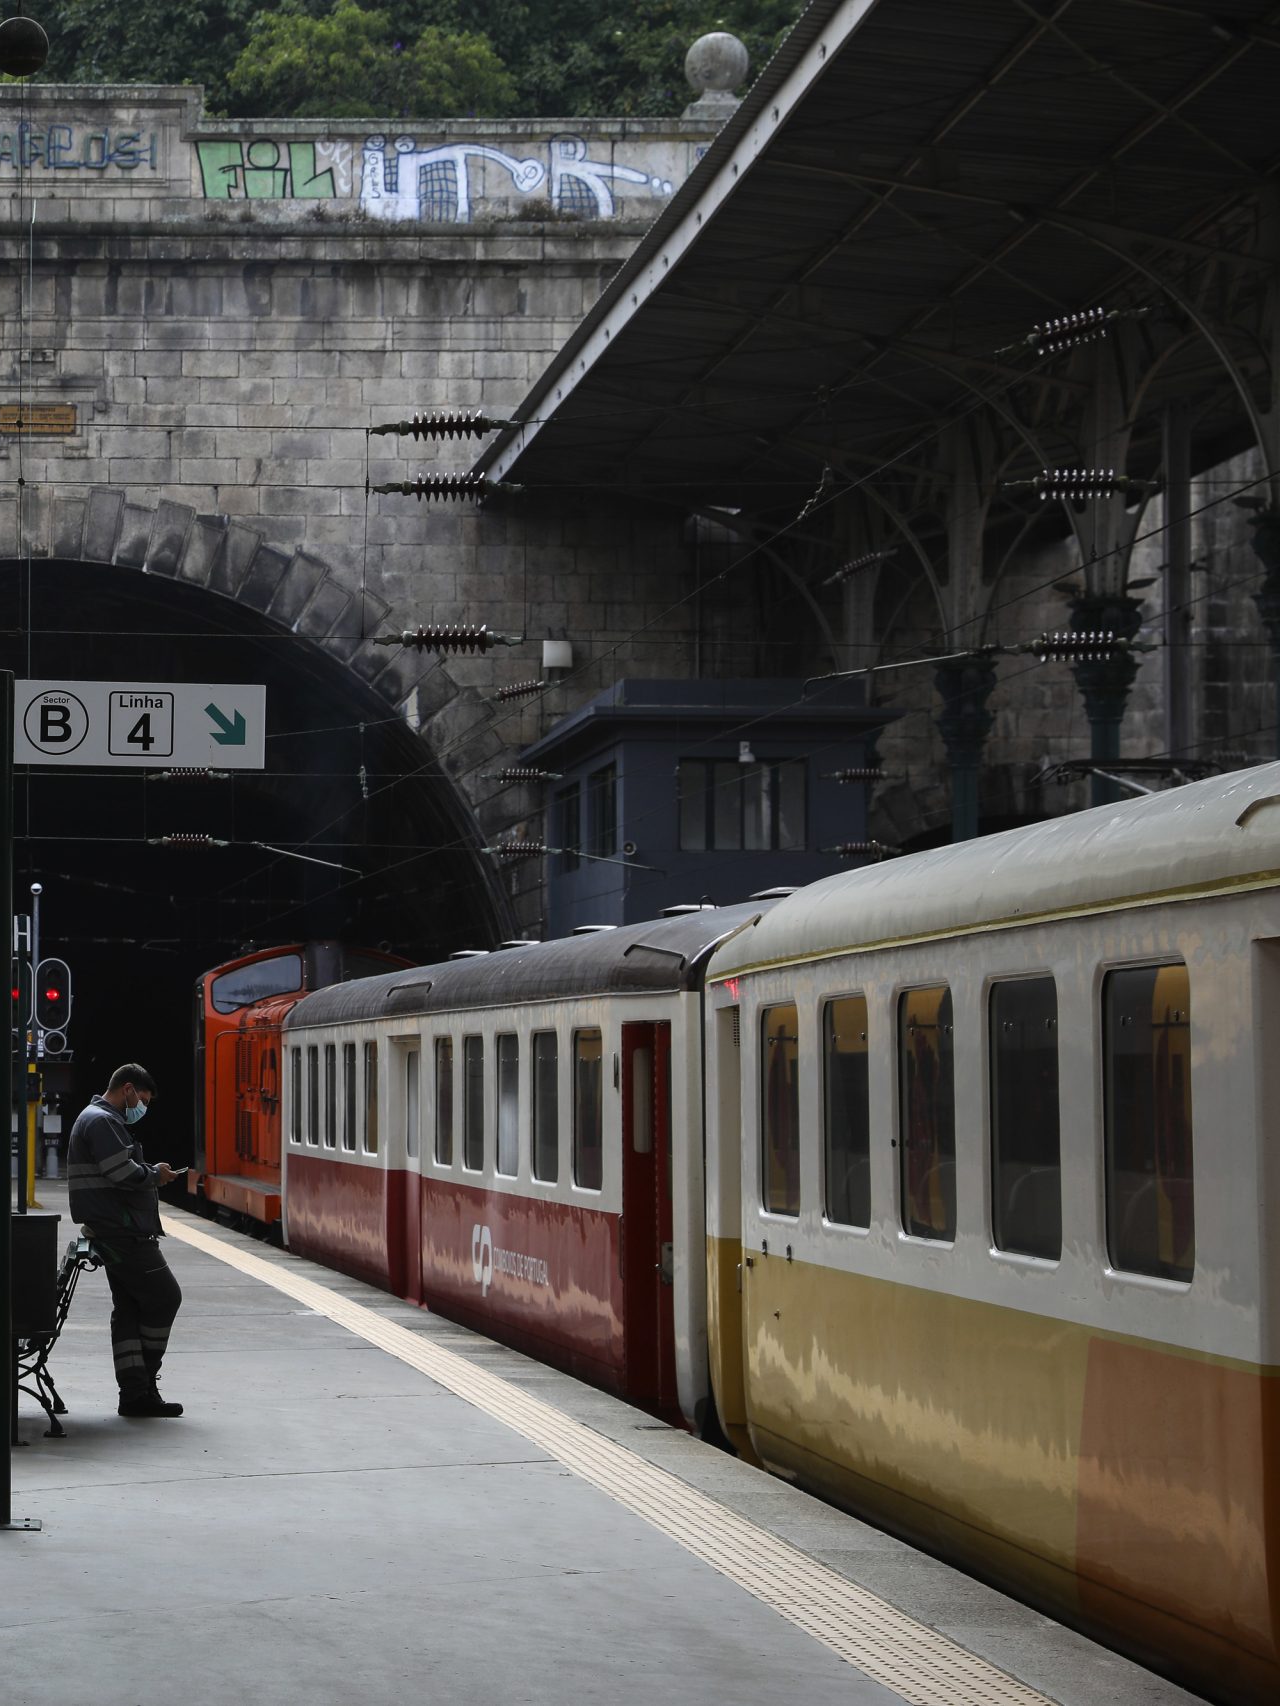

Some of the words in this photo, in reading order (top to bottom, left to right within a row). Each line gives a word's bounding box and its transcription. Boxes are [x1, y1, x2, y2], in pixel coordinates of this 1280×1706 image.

[43, 696, 71, 704] Sector
[119, 695, 164, 709] Linha
[40, 704, 72, 743] B
[127, 712, 155, 751] 4
